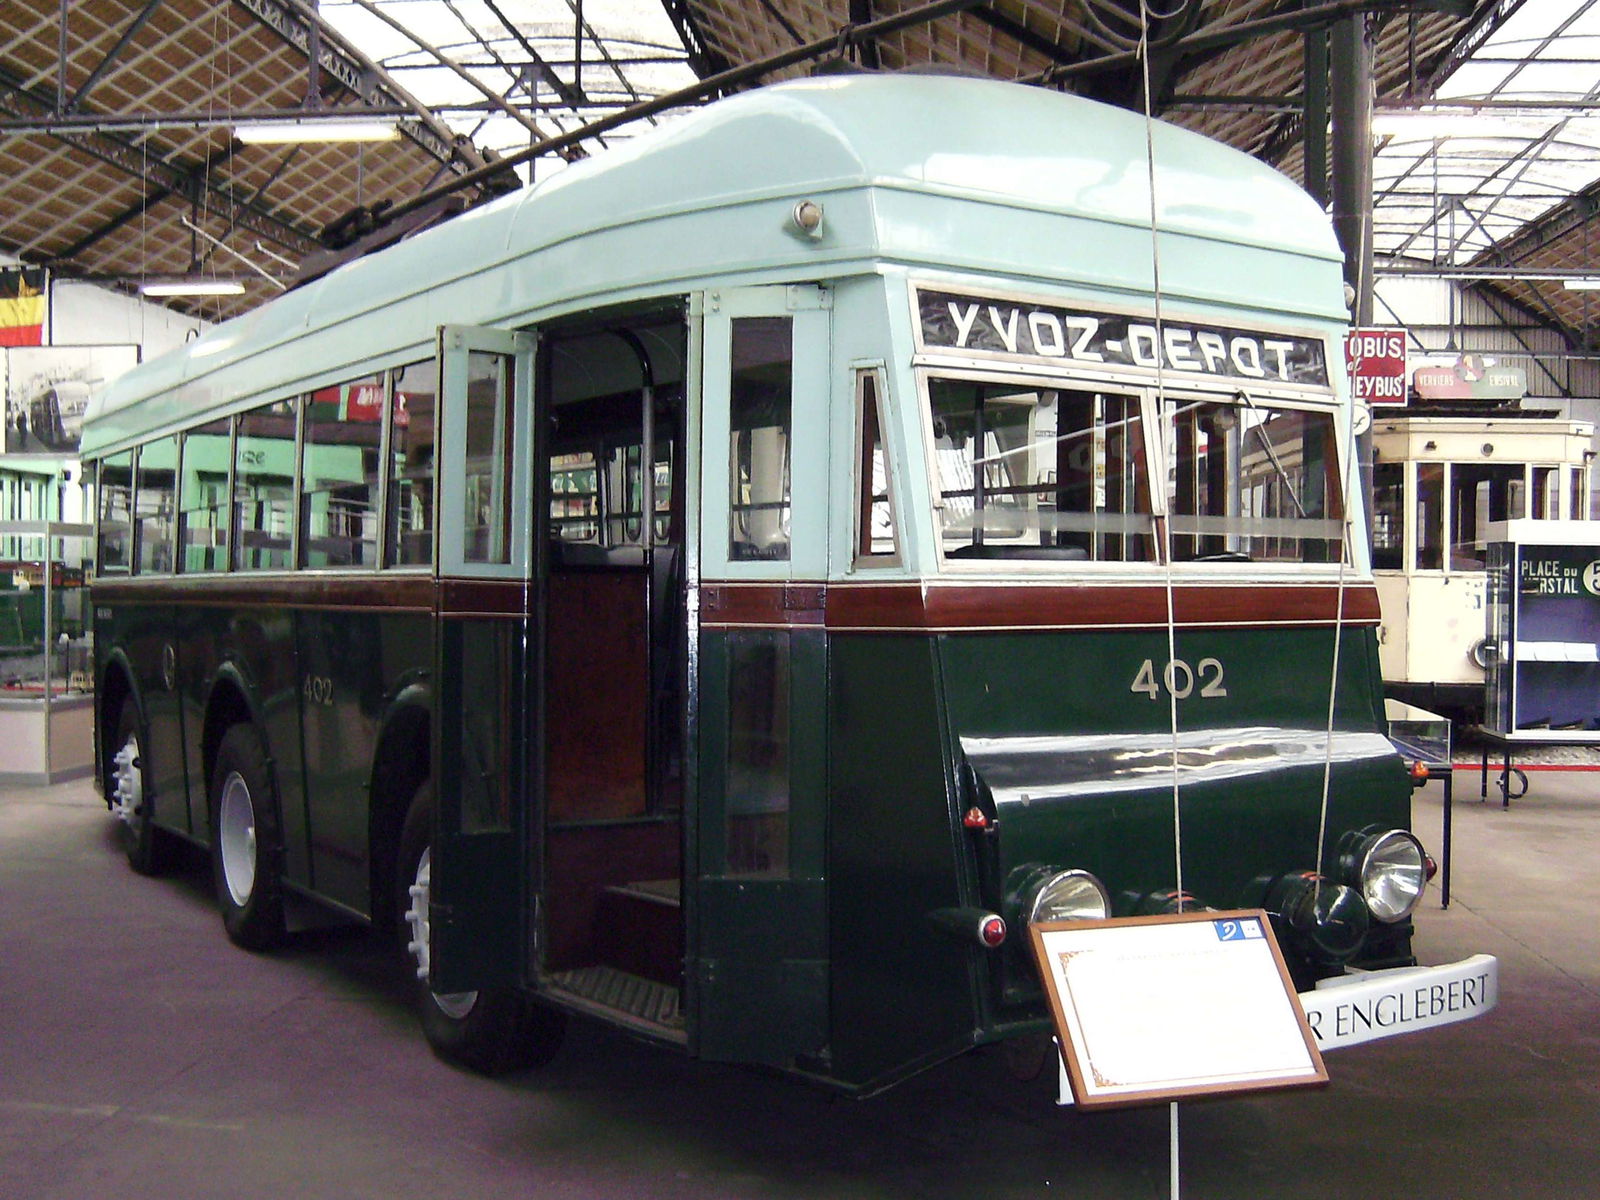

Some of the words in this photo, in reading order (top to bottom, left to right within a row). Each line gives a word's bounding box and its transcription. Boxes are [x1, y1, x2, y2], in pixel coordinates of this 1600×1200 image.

[947, 301, 1293, 381] YVOZ-DEPOT
[1521, 560, 1560, 577] PLACE
[1563, 568, 1578, 577] DU
[304, 673, 333, 706] 402
[1131, 657, 1228, 700] 402
[1335, 973, 1489, 1037] ENGLEBERT
